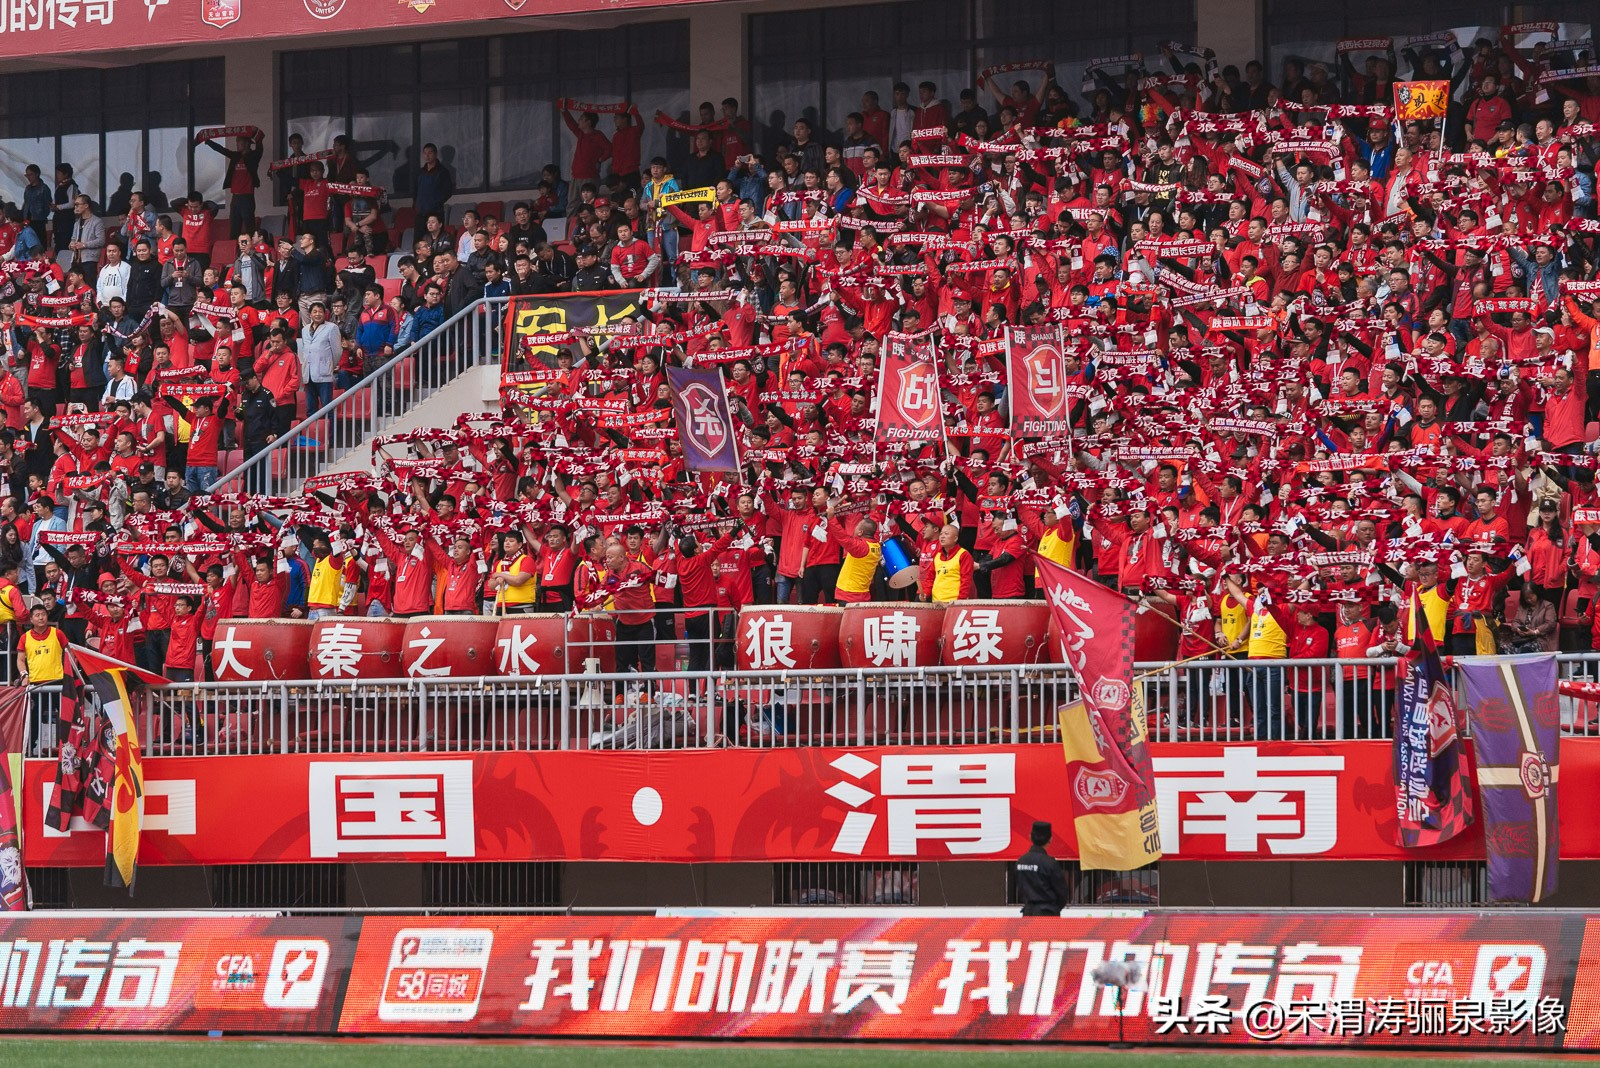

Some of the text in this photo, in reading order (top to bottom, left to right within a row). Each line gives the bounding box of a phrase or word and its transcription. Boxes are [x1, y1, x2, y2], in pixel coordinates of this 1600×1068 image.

[0, 0, 114, 33] 的传奇
[315, 6, 336, 14] UNITED
[1197, 121, 1246, 132] 狼道
[1264, 128, 1311, 142] 狼道
[1318, 180, 1365, 193] 狼道
[1161, 244, 1214, 256] 陕西长安竞技
[839, 276, 885, 288] 狼道
[1431, 360, 1485, 378] 狼道
[813, 377, 863, 389] 狼道
[950, 372, 1000, 386] 狼道
[1024, 420, 1067, 432] FIGHTING
[1455, 421, 1511, 433] 狼道
[887, 428, 939, 438] FIGHTING
[797, 445, 845, 456] 狼道
[848, 480, 903, 493] 狼道
[1177, 527, 1228, 541] 狼道
[1385, 549, 1439, 563] 狼道
[1149, 577, 1197, 590] 狼道
[1285, 588, 1362, 603] 狼道
[214, 624, 542, 679] 大秦之水
[215, 954, 254, 976] CFA
[519, 938, 918, 1014] 我们的联赛
[1407, 960, 1453, 985] CFA
[396, 970, 470, 1000] 58同城
